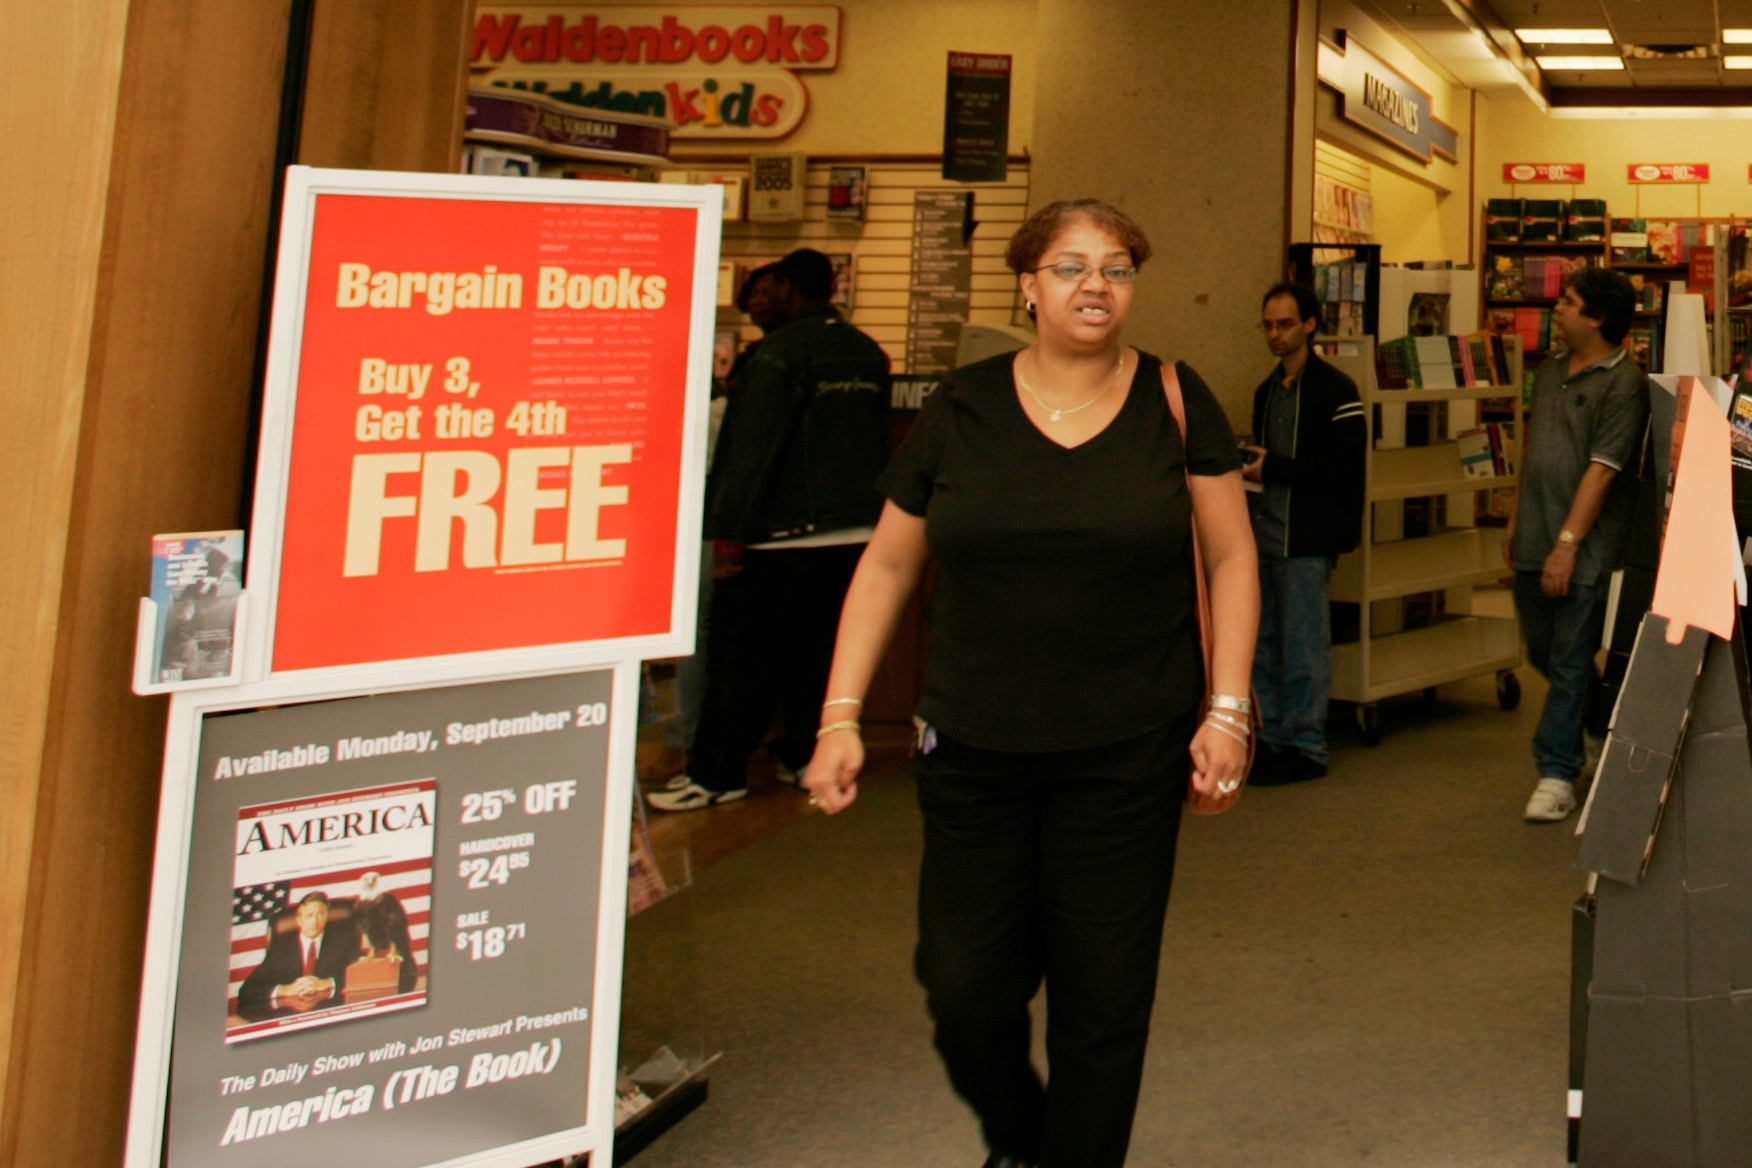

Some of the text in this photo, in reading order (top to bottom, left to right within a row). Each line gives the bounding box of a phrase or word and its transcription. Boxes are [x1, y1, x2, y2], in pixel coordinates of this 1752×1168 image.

[1363, 72, 1418, 135] MAGAZINES
[336, 263, 667, 316] Bargain Books
[359, 356, 480, 399] Buy 3,
[355, 401, 567, 442] Get the 4th
[343, 443, 633, 578] FREE
[213, 702, 608, 780] Available Monday, September 20
[237, 801, 433, 856] AMERICA
[461, 779, 577, 825] 25% OFF
[459, 832, 535, 856] HARDCOVER
[456, 910, 489, 929] SALE
[220, 1005, 589, 1097] The Daily Show with Jon Stewart Presents
[219, 1038, 562, 1148] America (The Book)
